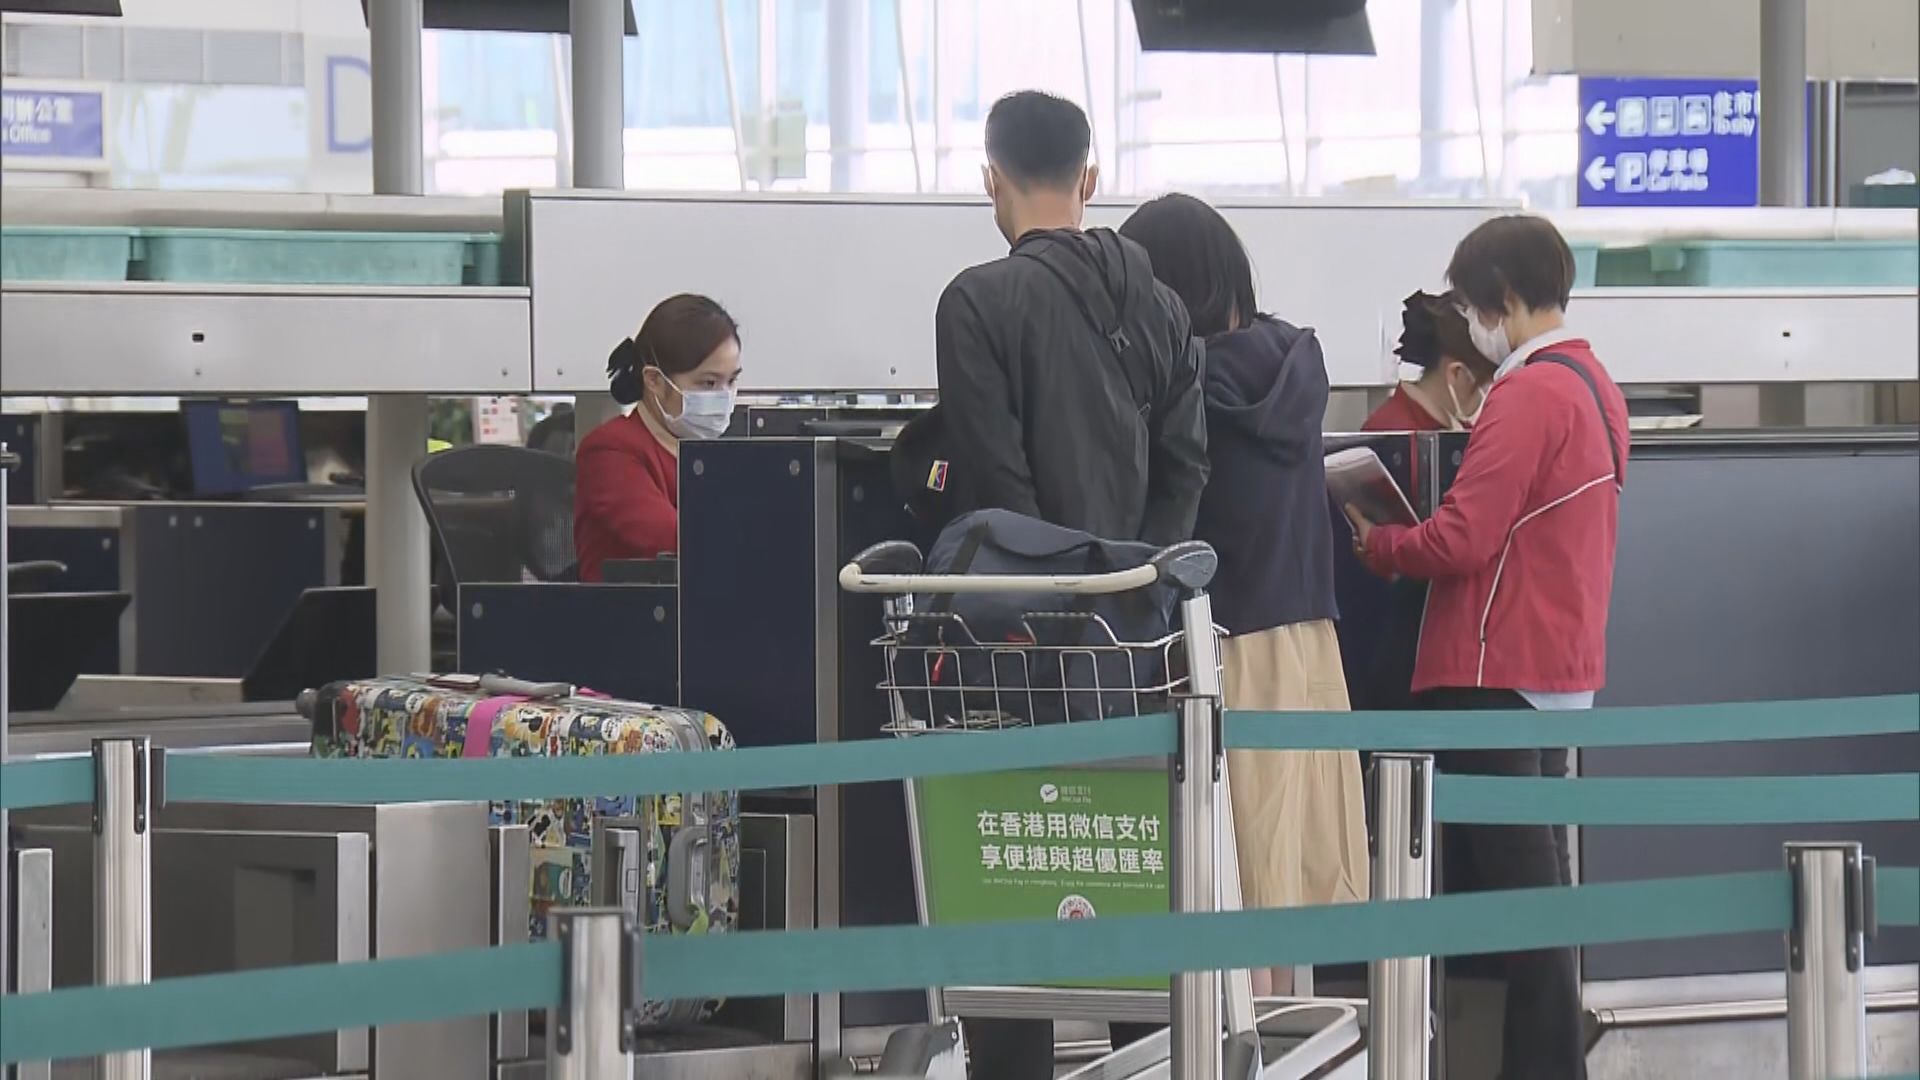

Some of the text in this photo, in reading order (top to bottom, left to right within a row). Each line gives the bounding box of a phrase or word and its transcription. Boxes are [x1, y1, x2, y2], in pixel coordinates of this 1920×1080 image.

[327, 56, 371, 153] D
[977, 810, 1160, 841] 在香港用微信支付
[980, 844, 1164, 875] 享便捷與超優匯率
